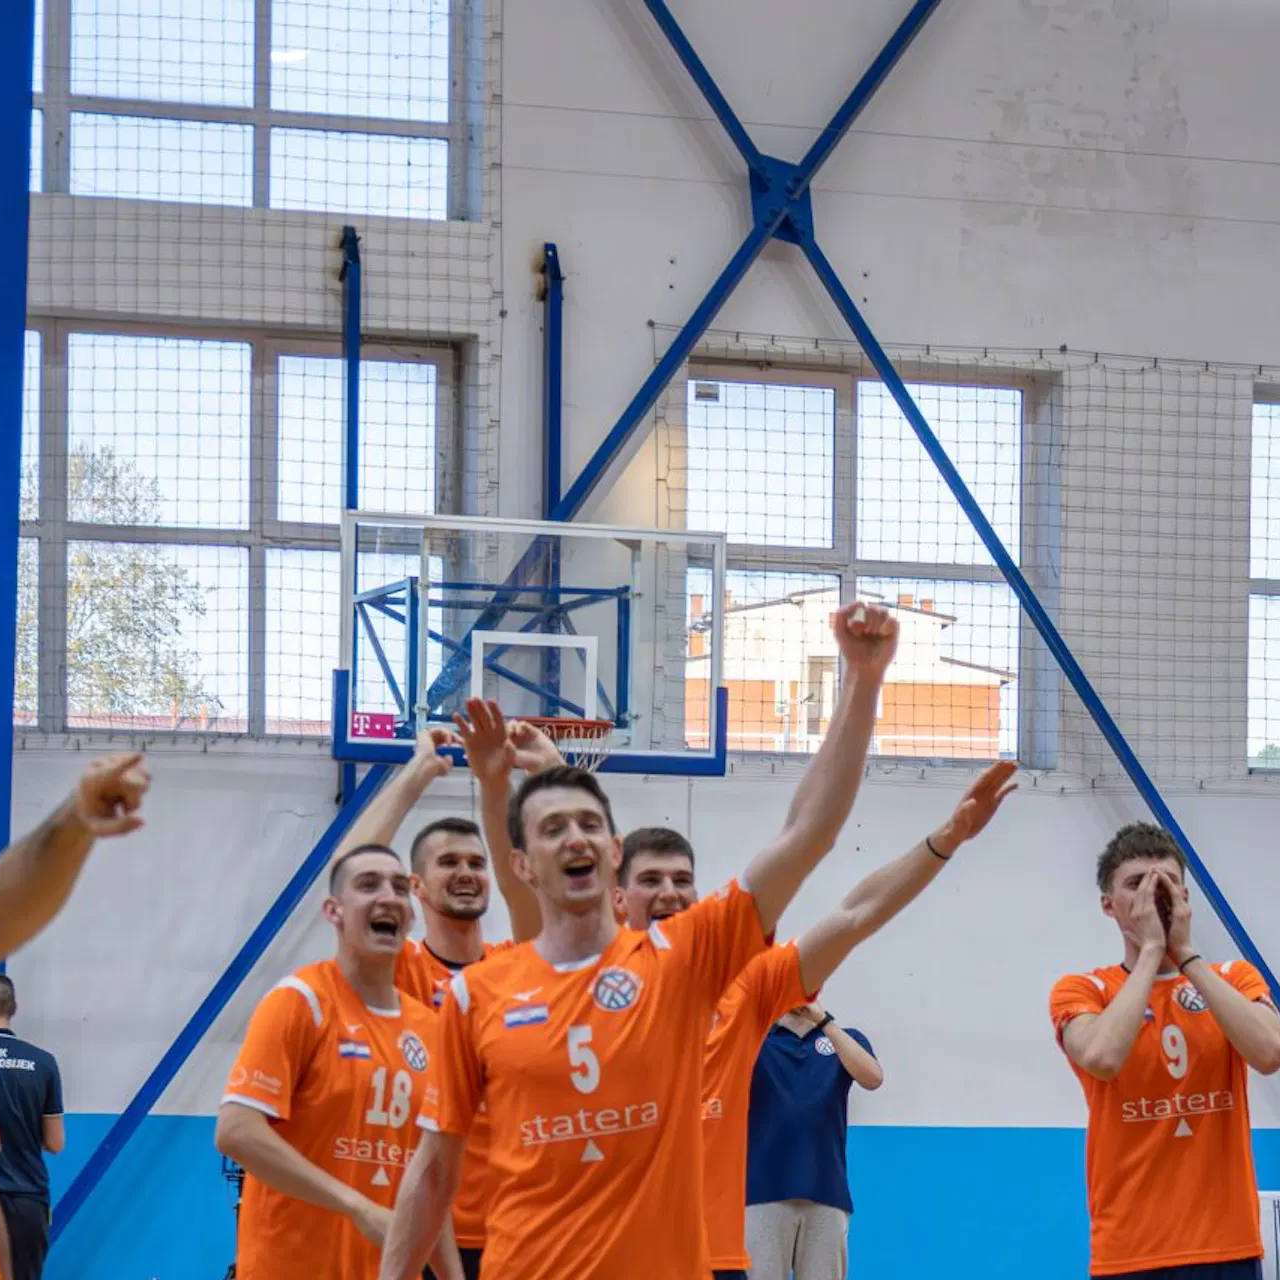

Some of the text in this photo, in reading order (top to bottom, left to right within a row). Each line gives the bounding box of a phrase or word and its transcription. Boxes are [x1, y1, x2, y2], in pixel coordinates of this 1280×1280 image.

[567, 1024, 600, 1094] 5
[1161, 1023, 1189, 1080] 9
[365, 1066, 412, 1128] 18
[520, 1101, 659, 1142] statera
[1122, 1090, 1234, 1120] statera
[334, 1137, 417, 1165] stater
